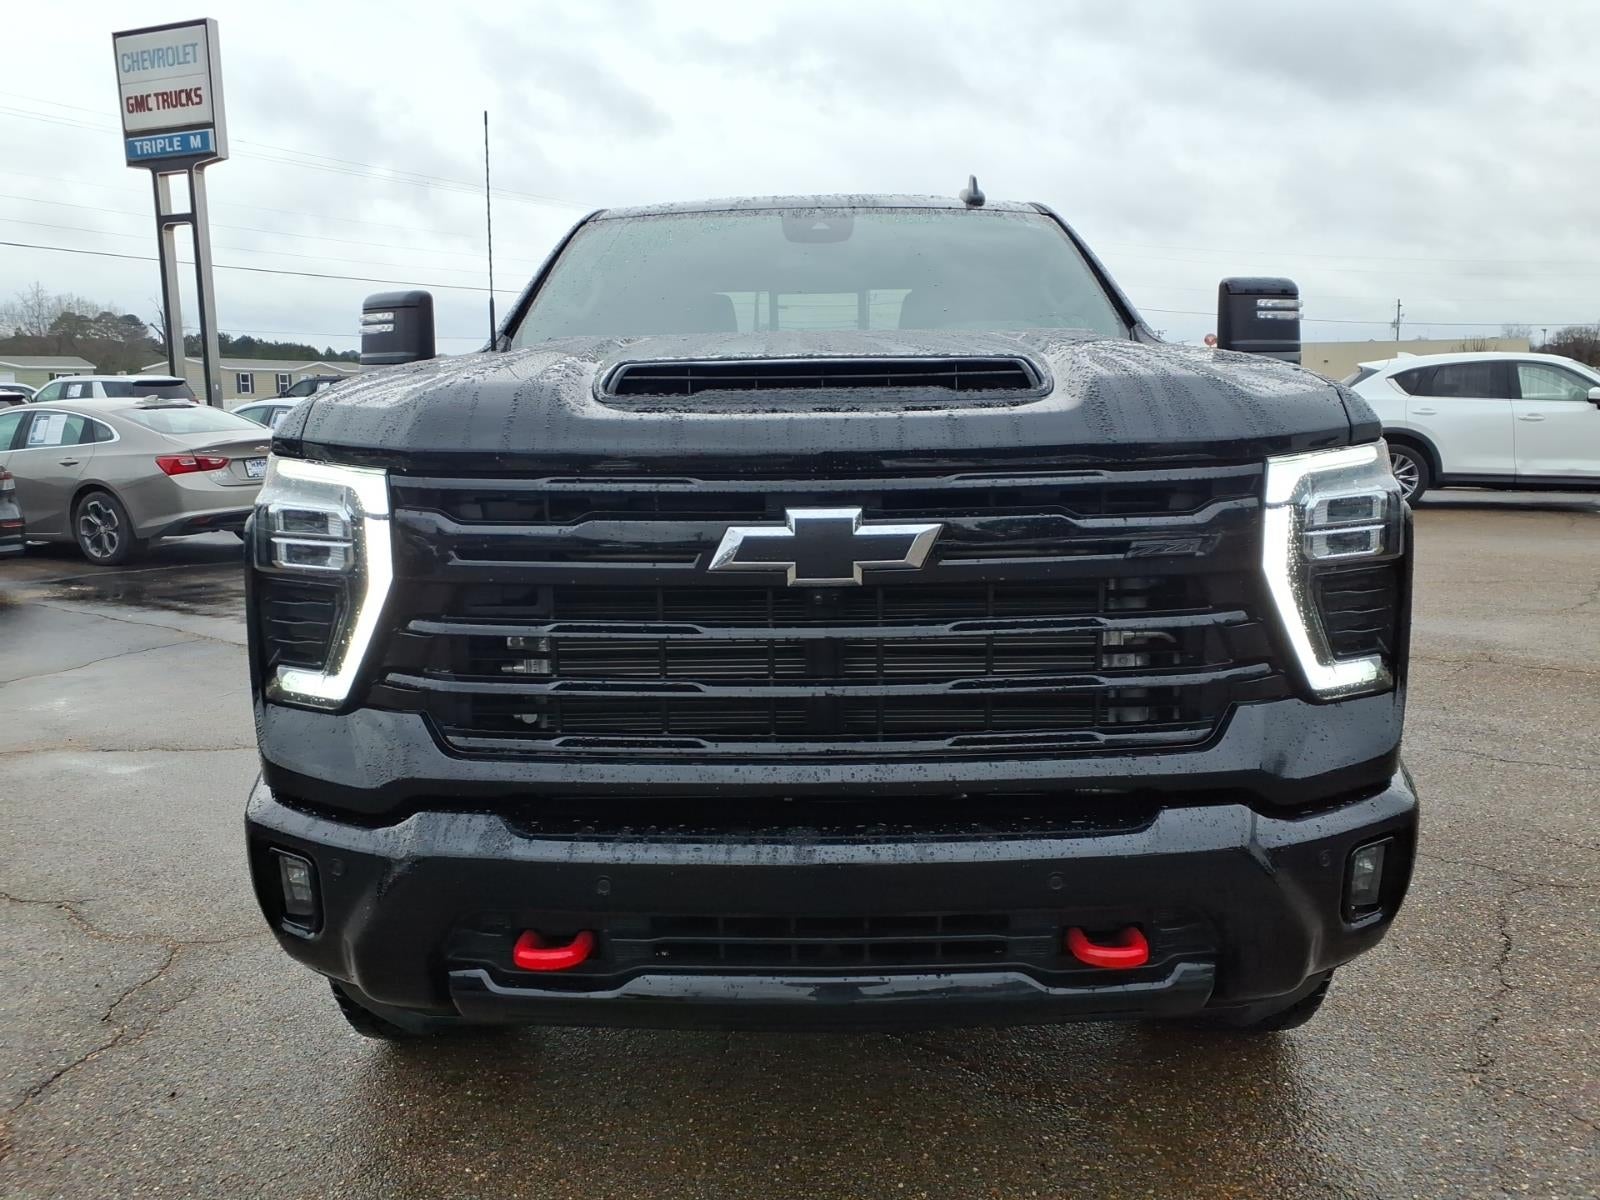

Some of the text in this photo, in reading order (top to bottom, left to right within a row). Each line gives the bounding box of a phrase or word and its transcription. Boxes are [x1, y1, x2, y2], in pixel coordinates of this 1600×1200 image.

[121, 43, 198, 73] CHEVROLET
[126, 87, 203, 114] GMC TRUCKS
[134, 135, 202, 155] TRIPLE M
